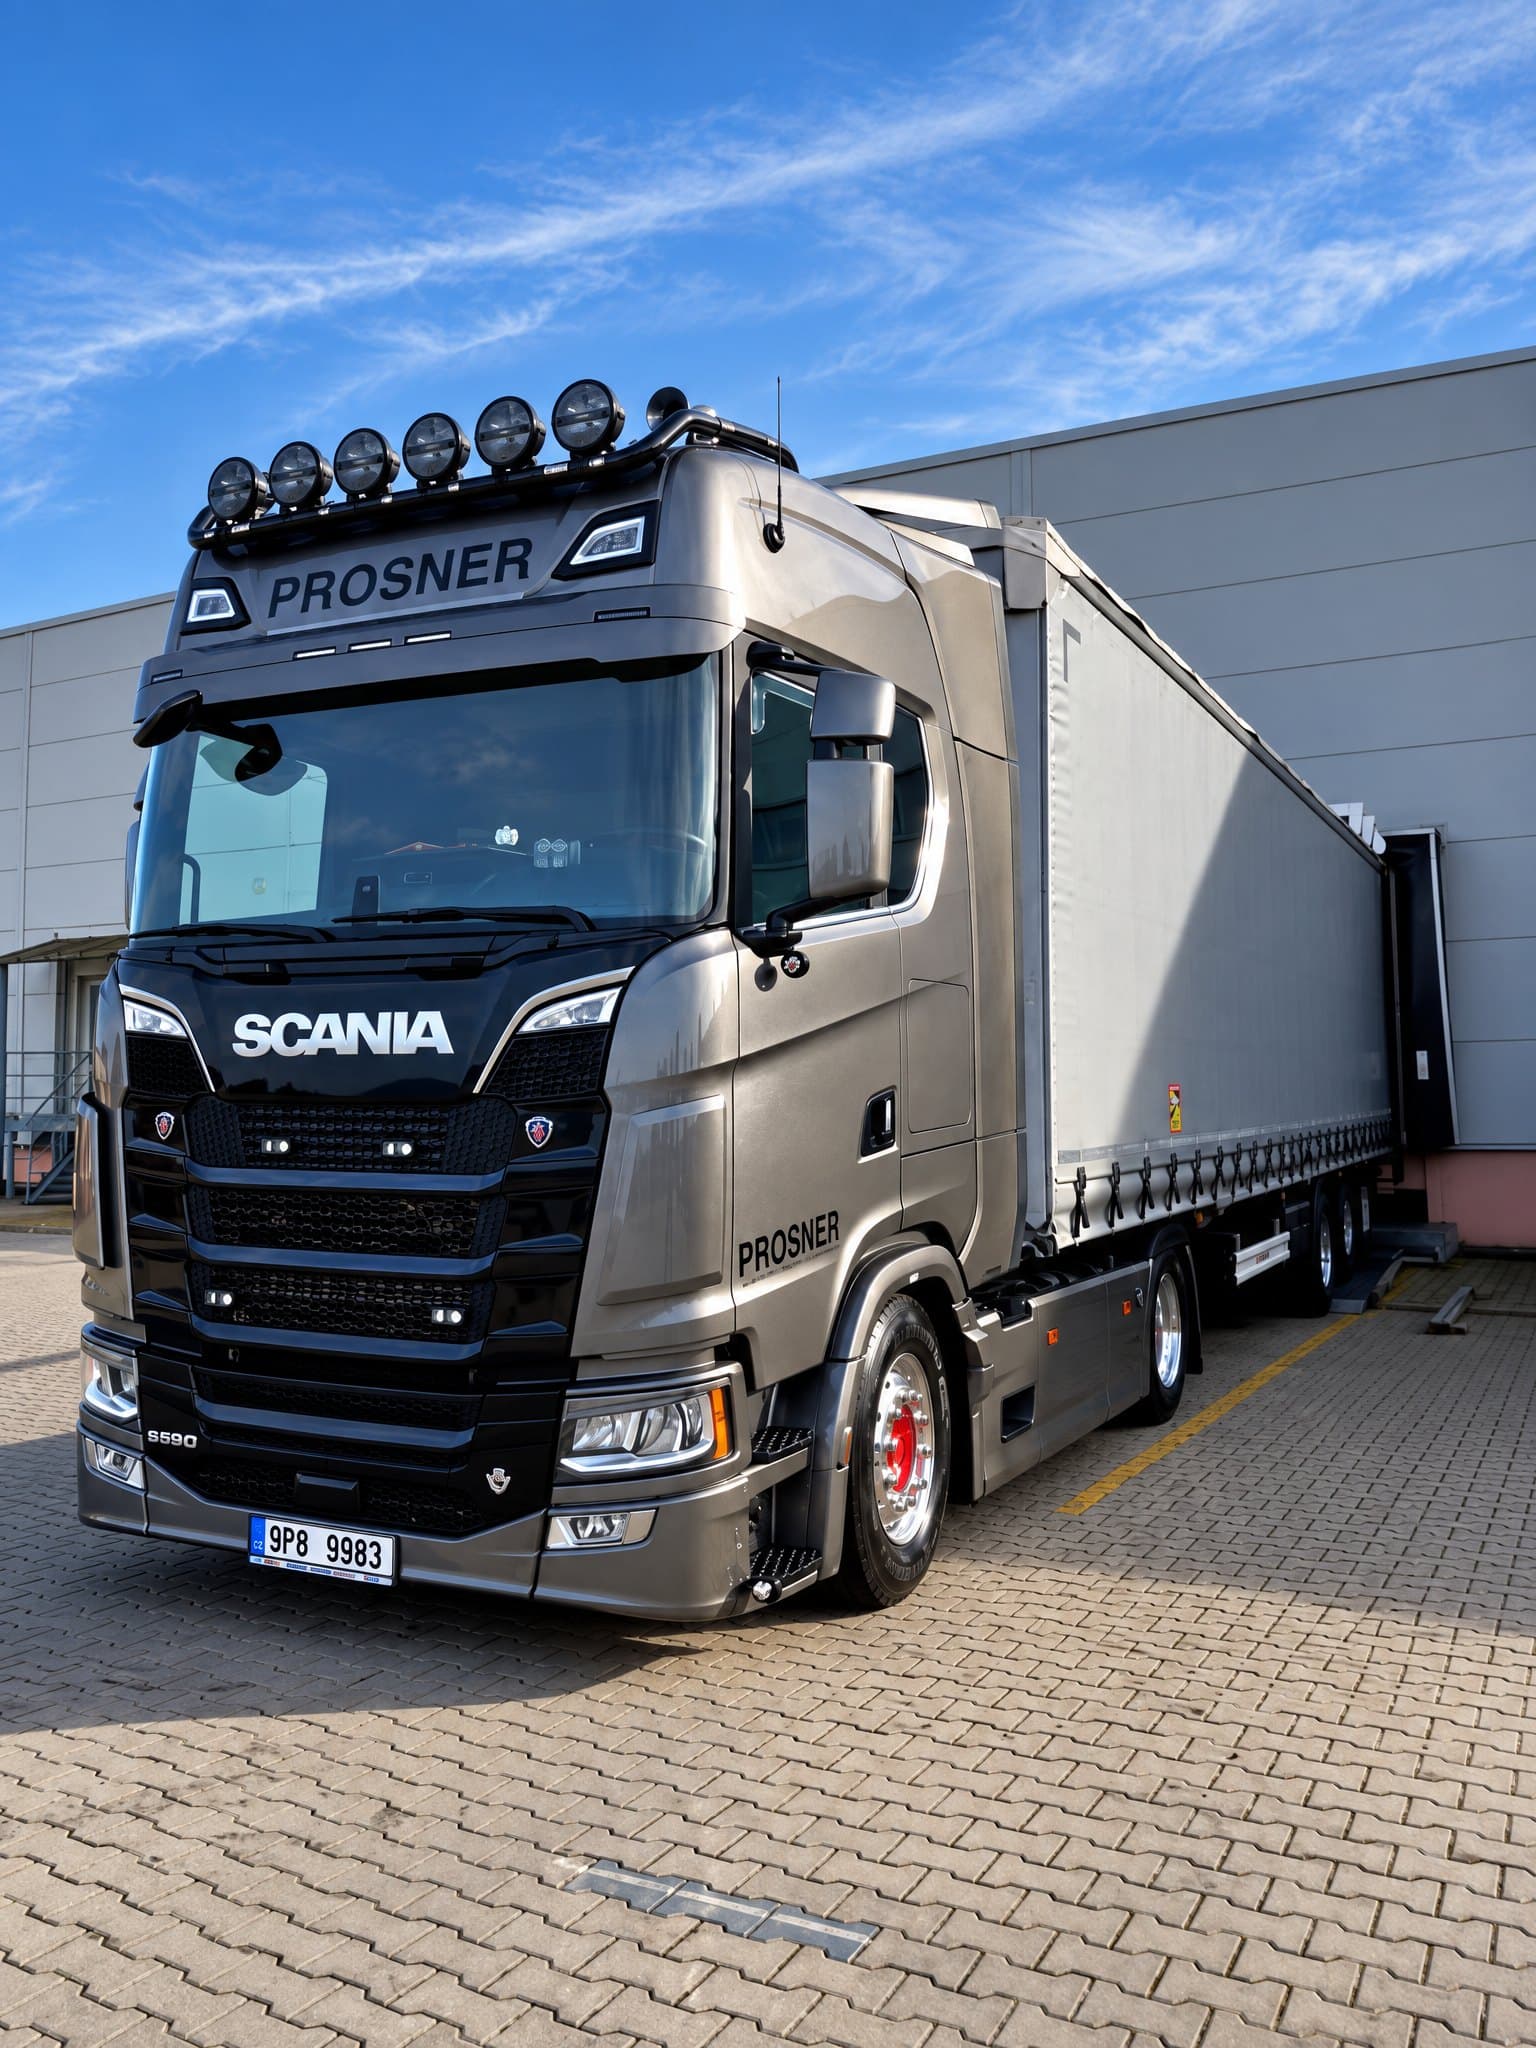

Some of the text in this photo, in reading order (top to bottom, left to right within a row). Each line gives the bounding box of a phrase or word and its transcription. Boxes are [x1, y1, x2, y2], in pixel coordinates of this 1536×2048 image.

[268, 538, 532, 618] PROSNER
[232, 1011, 454, 1057] SCANIA
[739, 1210, 839, 1278] PROSNER
[147, 1430, 197, 1448] S590
[270, 1525, 382, 1569] 9P8 9983
